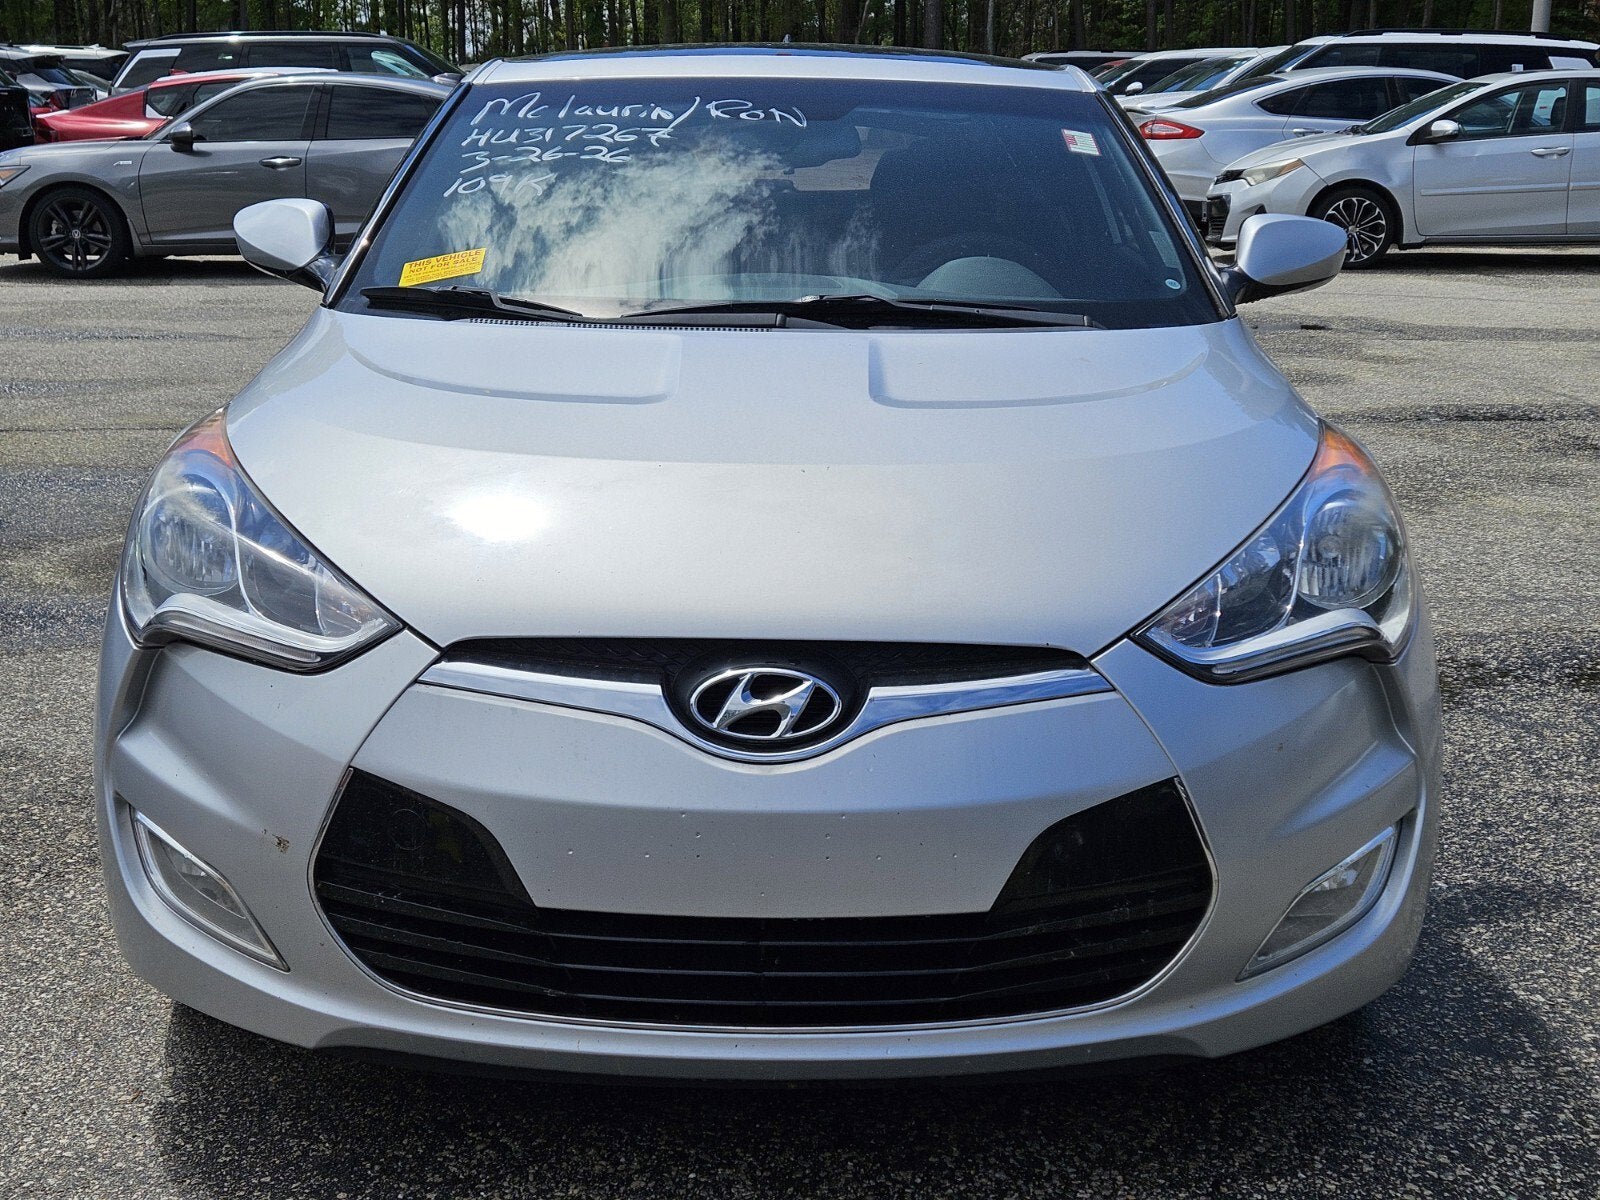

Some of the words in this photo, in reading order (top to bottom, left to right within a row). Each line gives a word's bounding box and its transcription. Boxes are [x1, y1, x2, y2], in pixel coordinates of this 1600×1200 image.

[459, 145, 632, 174] 3-26-26
[408, 259, 432, 269] THIS
[436, 249, 482, 263] VEHICLE
[409, 266, 429, 275] NOT
[453, 256, 478, 265] SALE
